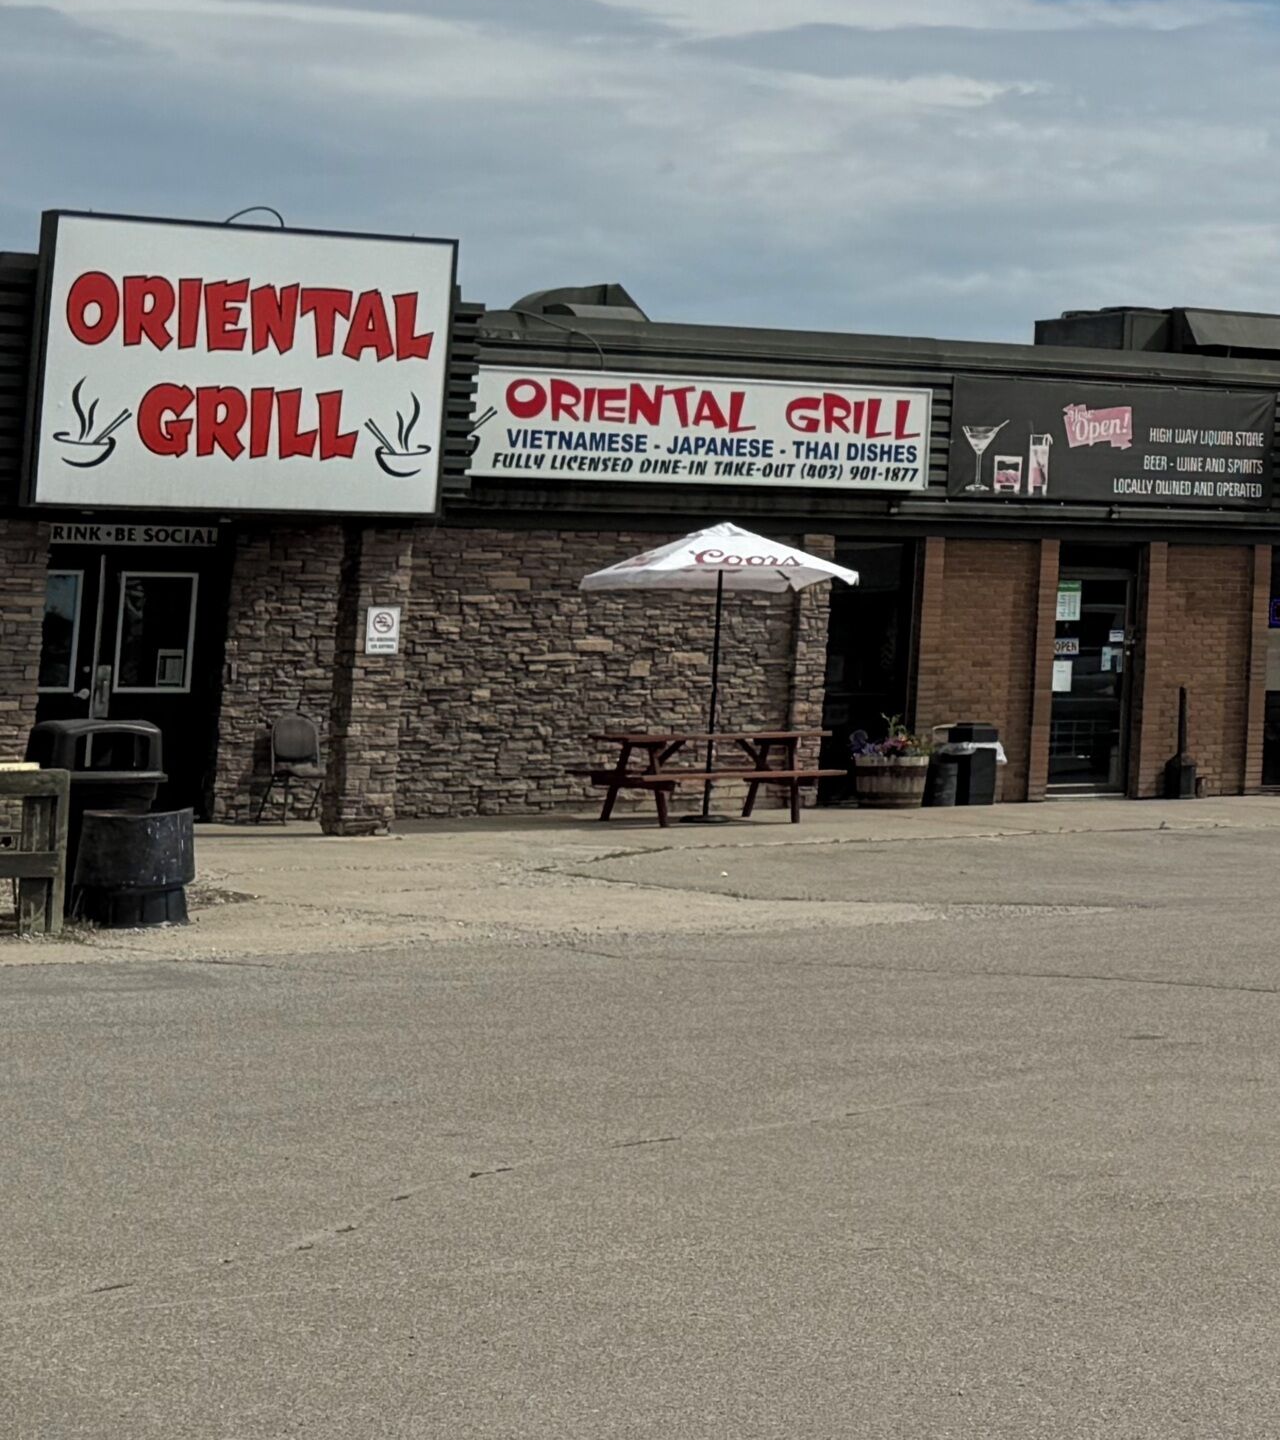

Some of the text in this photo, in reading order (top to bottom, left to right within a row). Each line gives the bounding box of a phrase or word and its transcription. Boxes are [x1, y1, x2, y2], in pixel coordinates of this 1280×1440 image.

[66, 271, 434, 362] ORIENTAL
[136, 382, 359, 461] GRILL
[505, 378, 921, 441] ORIENTAL GRILL
[1075, 412, 1130, 447] Open!
[1149, 428, 1264, 447] HIGH WAY LIQUOR STORE
[506, 428, 648, 453] VIETNAMESE
[666, 436, 774, 458] JAPANESE
[793, 441, 839, 460] THAI
[847, 443, 917, 464] DISHES
[492, 453, 919, 483] FULLY LICENSED DINE-IN TAKE-OUT (403) 901-1877
[1143, 454, 1168, 471] BEER
[1176, 456, 1203, 472] WINE
[1205, 457, 1226, 473] AND
[1227, 458, 1264, 474] SPIRITS
[1113, 478, 1263, 498] LOCALLY OWNED AND OPERATED
[114, 526, 137, 542] BE
[143, 527, 217, 545] SOCIAL
[694, 548, 804, 567] Coors
[1055, 639, 1078, 652] OPEN
